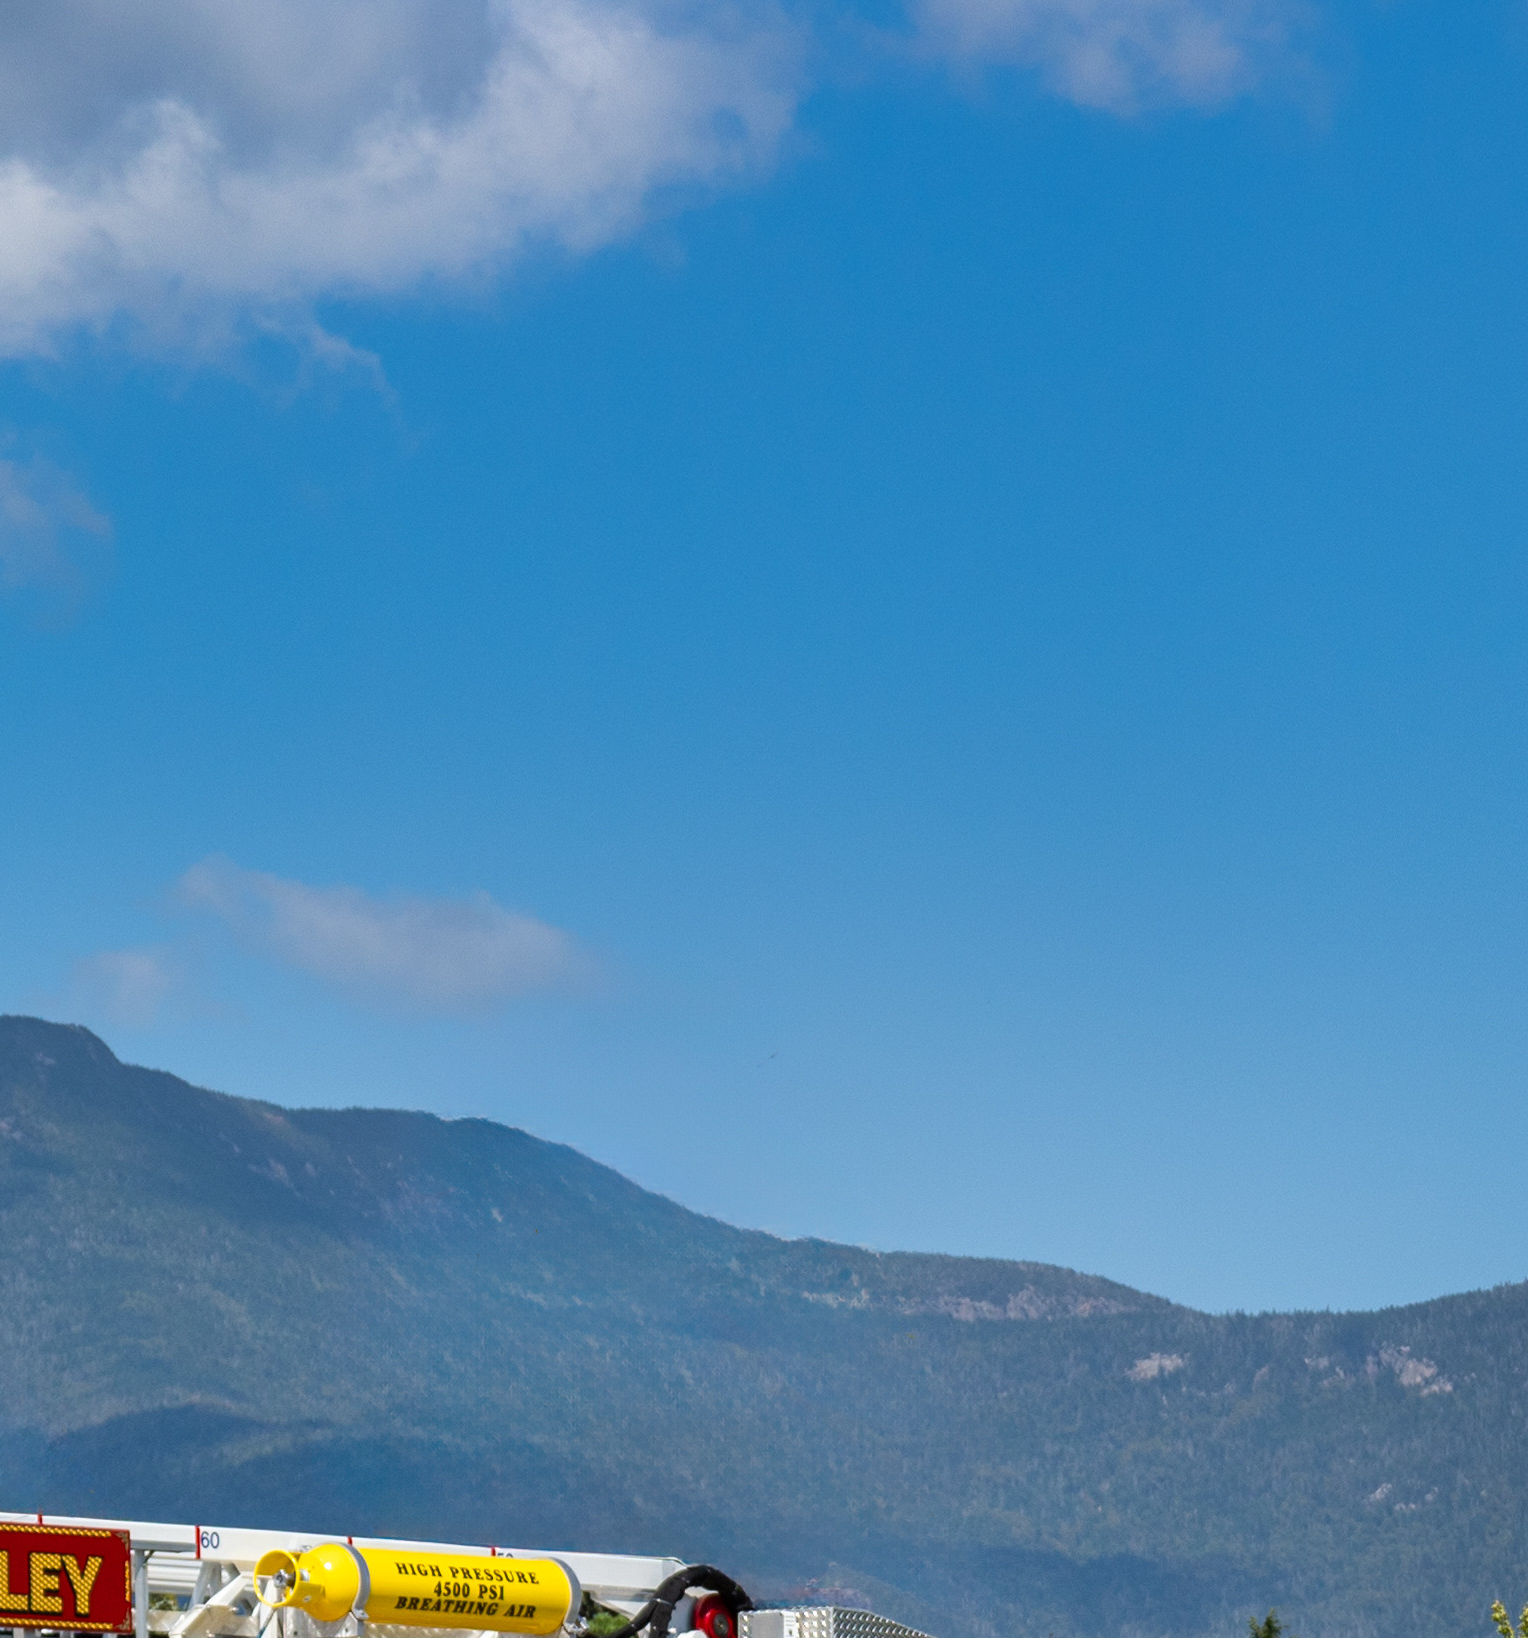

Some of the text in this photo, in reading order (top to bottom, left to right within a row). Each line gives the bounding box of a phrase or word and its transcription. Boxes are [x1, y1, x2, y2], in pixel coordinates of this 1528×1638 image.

[200, 1531, 221, 1549] 60
[394, 1562, 540, 1585] HIGH PRESSURE
[433, 1581, 505, 1601] 4500 PSI
[394, 1596, 537, 1619] BREATHING AIR
